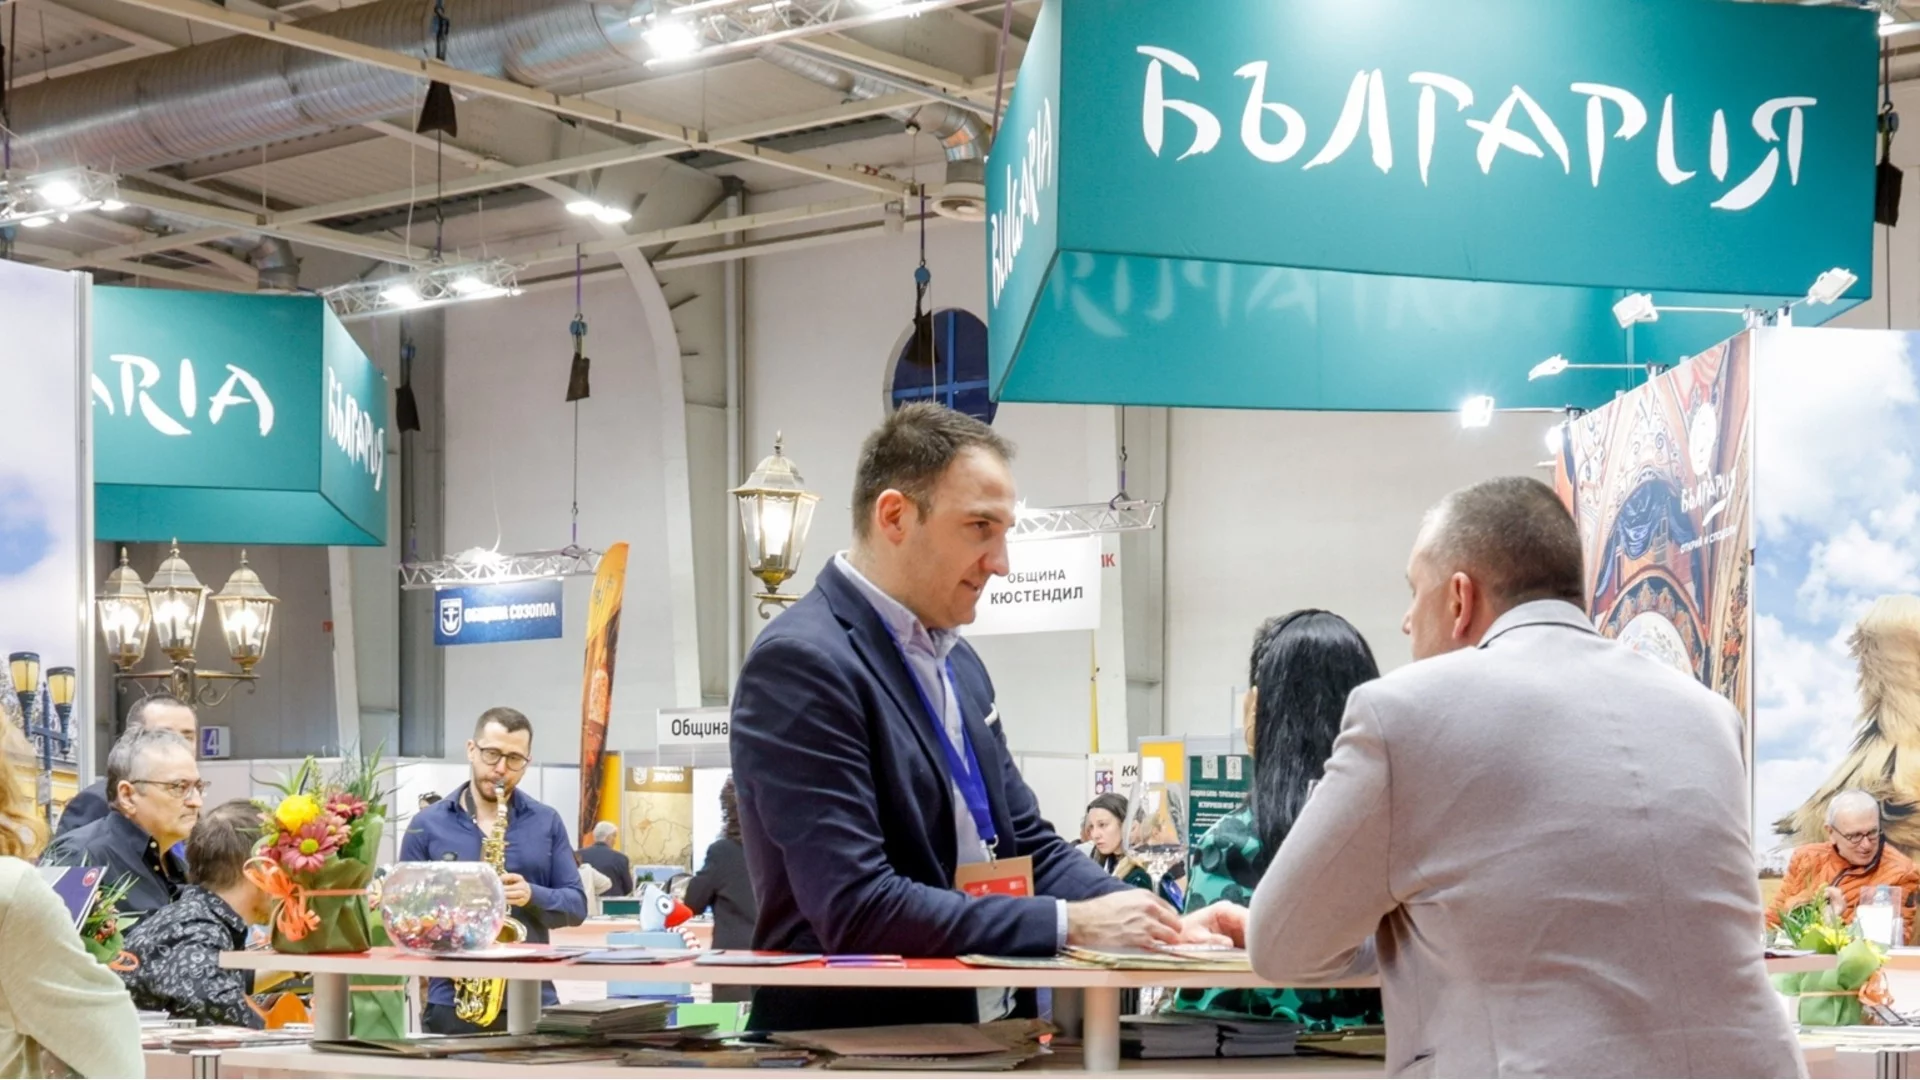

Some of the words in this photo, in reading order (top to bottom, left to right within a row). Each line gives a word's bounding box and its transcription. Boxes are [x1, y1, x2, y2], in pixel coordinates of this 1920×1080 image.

[1136, 46, 1818, 211] БЪЛГАРИЯ
[328, 366, 384, 492] БЪЛГАРИЯ
[1007, 569, 1066, 584] ОБЩИНА
[989, 586, 1084, 605] КЮСТЕНДИЛ
[509, 602, 557, 620] СОЗОПОЛ
[671, 718, 729, 739] Община
[206, 729, 220, 755] 4
